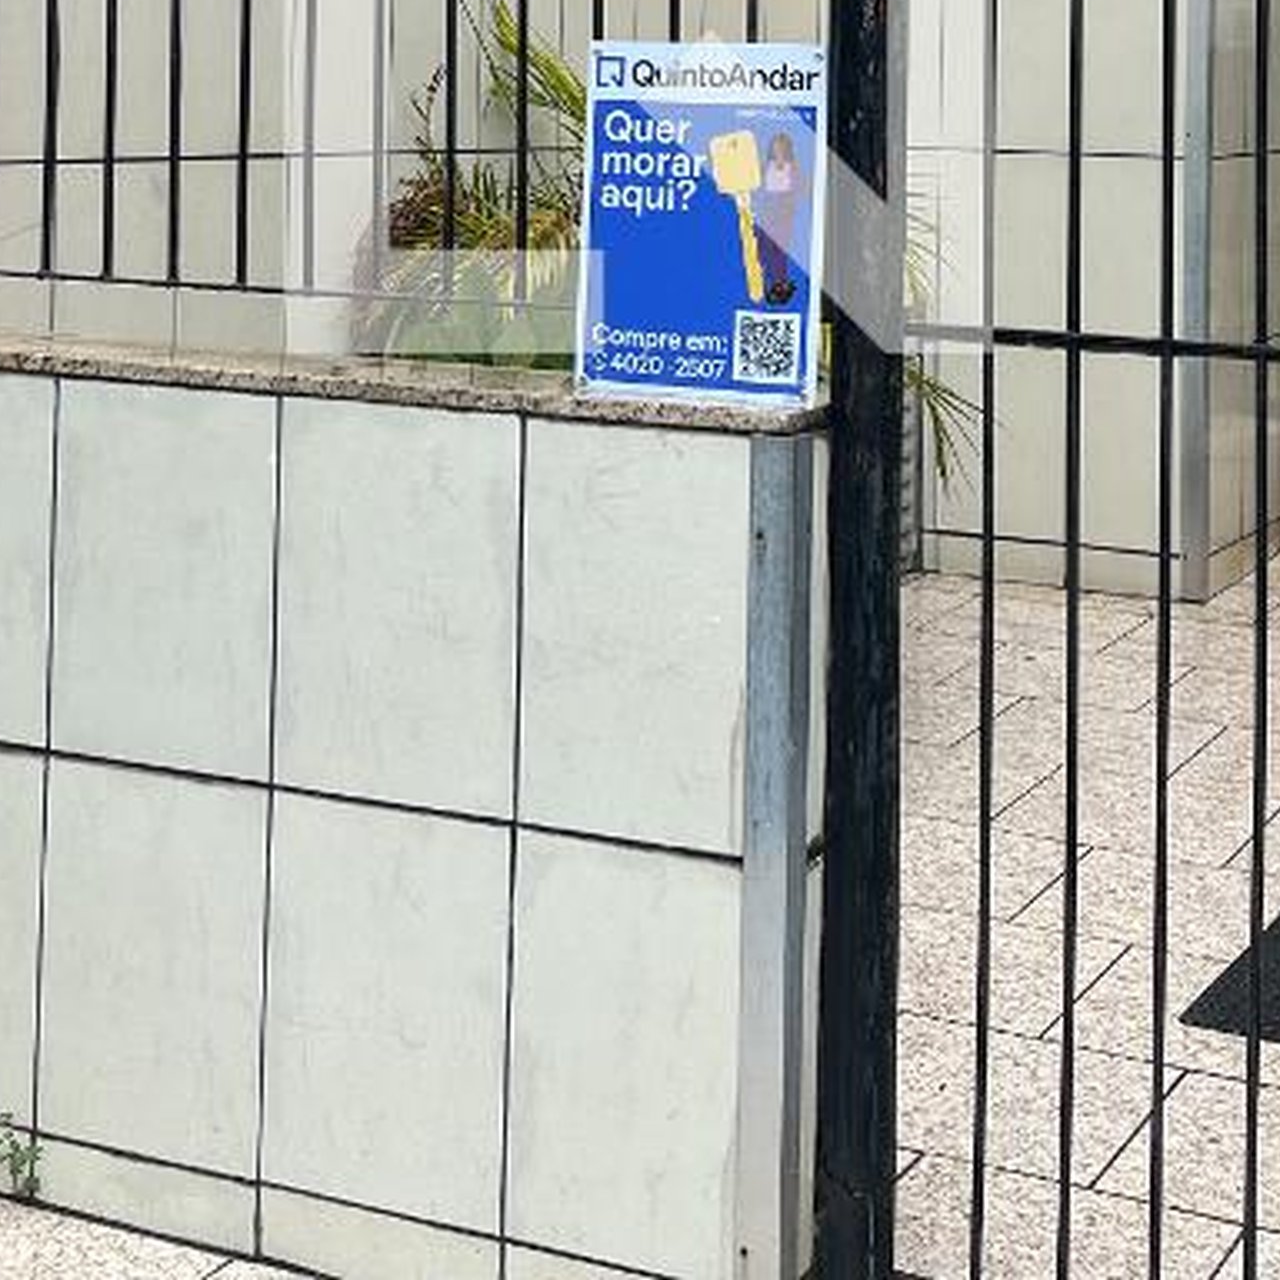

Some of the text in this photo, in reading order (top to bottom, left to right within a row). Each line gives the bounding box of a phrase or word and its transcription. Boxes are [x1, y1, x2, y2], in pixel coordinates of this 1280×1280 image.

[632, 59, 819, 91] QuintoAndar
[604, 109, 692, 144] Quer
[601, 150, 708, 178] morar
[600, 179, 698, 218] aqui?
[592, 321, 681, 353] Compre
